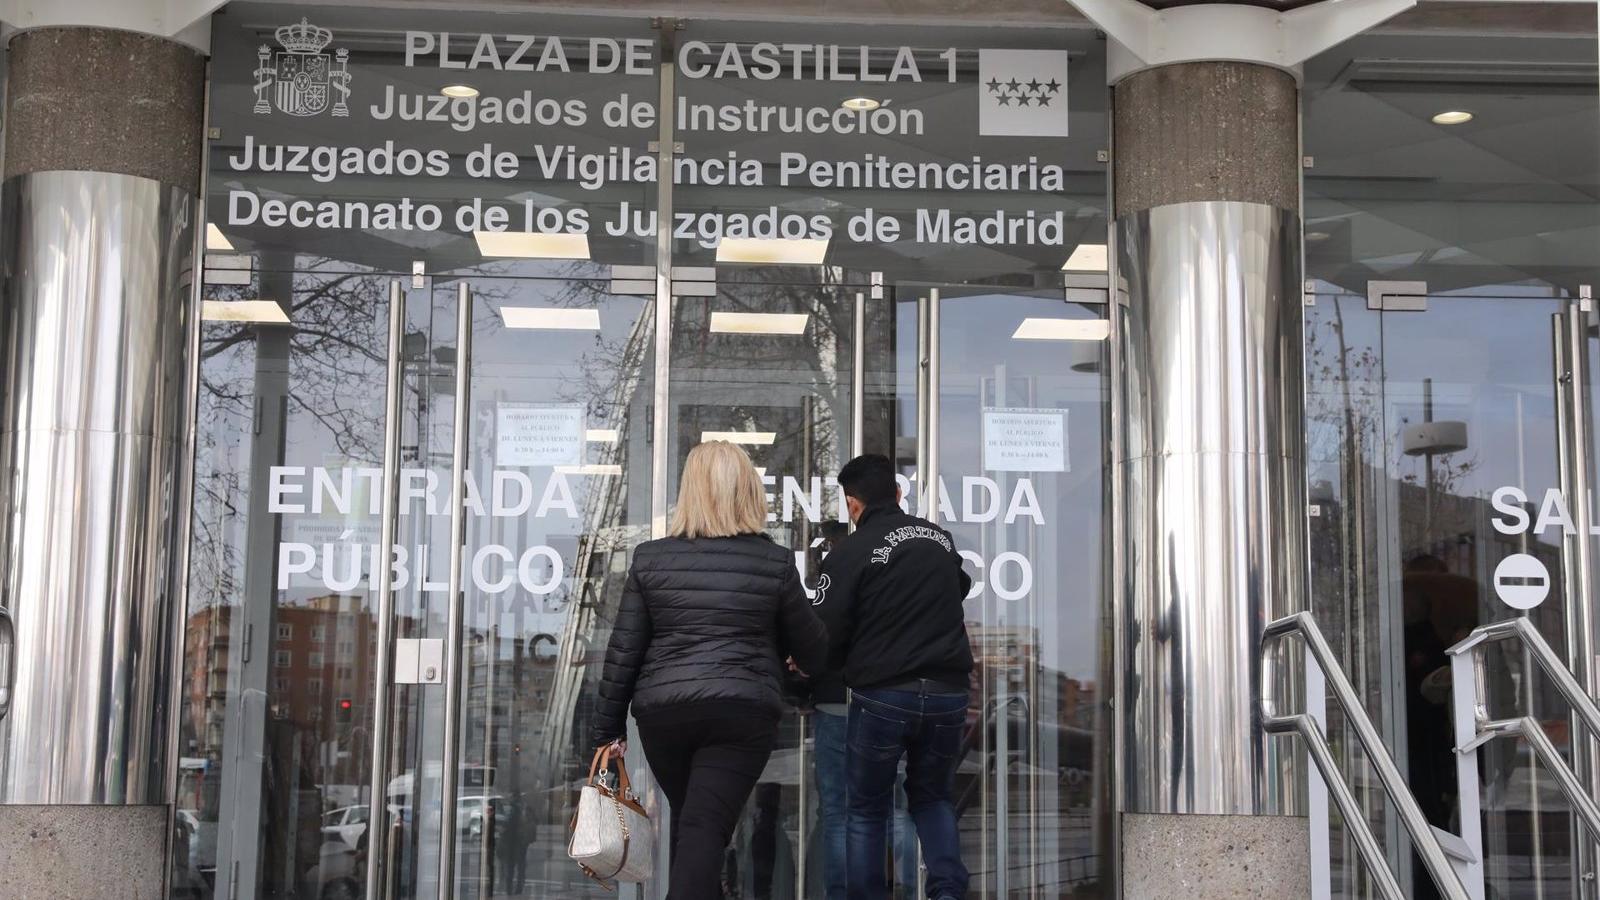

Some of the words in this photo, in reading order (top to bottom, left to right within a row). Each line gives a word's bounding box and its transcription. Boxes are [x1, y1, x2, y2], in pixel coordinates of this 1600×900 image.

[404, 30, 571, 73] PLAZA
[588, 38, 655, 76] DE
[678, 41, 923, 83] CASTILLA
[939, 48, 958, 83] 1
[370, 85, 588, 132] Juzgados
[602, 93, 656, 128] de
[678, 95, 925, 135] Instrucción
[229, 135, 450, 183] Juzgados
[465, 143, 520, 179] de
[534, 143, 764, 191] Vigilancia
[779, 151, 1065, 192] Penitenciaria
[228, 190, 442, 229] Decanato
[455, 197, 510, 233] de
[524, 199, 590, 234] los
[605, 201, 833, 249] Juzgados
[847, 207, 901, 243] de
[916, 208, 1064, 246] Madrid
[268, 466, 579, 518] ENTRADA
